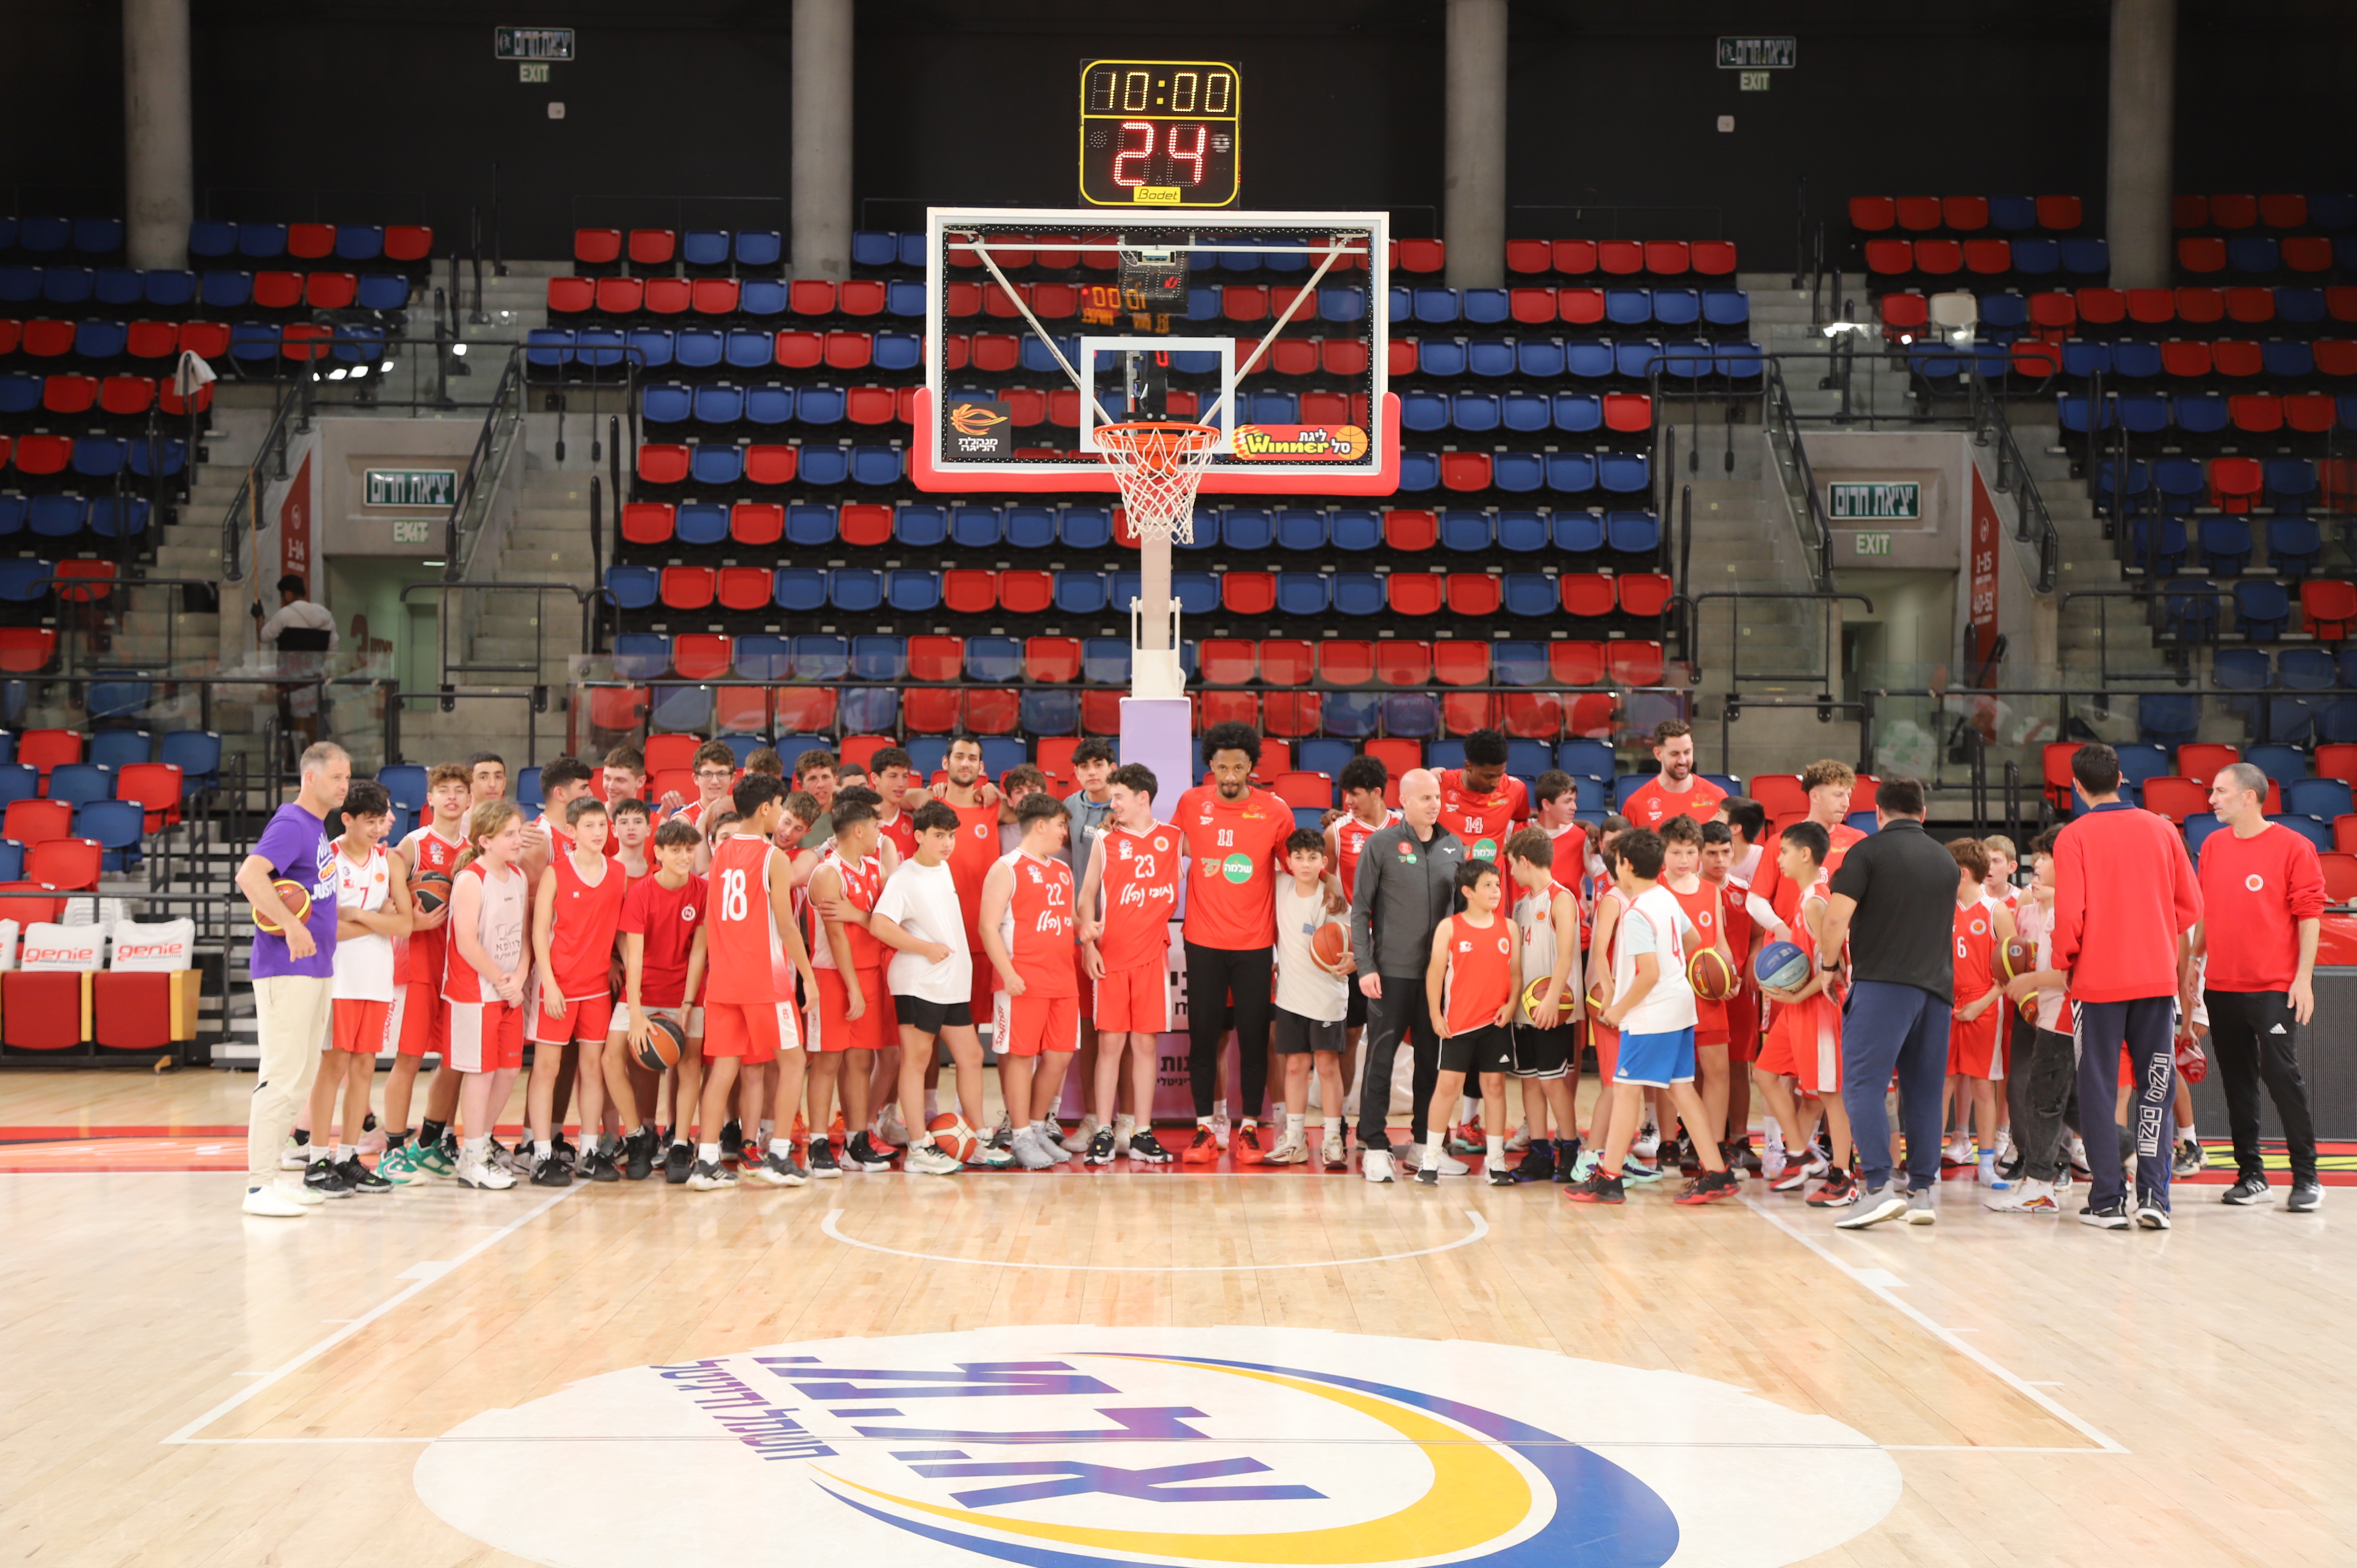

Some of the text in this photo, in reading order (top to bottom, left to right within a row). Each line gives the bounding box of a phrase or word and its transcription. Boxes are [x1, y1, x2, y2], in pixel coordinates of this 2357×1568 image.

[520, 65, 550, 83] EXIT
[1740, 73, 1769, 91] EXIT
[1109, 71, 1231, 112] 10:00
[1113, 121, 1207, 186] 24
[1137, 189, 1178, 199] Bodet
[958, 437, 998, 446] מנהלת
[1245, 433, 1329, 454] Winner
[1299, 428, 1327, 442] ליגת
[1331, 438, 1351, 454] סל
[371, 474, 450, 504] יציאת חרום
[1835, 487, 1913, 515] יציאת חרום
[393, 521, 429, 543] EXIT
[1856, 534, 1890, 554] EXIT
[1464, 816, 1484, 834] 14
[1217, 828, 1234, 847] 11
[1473, 848, 1497, 857] שלמה
[1134, 854, 1155, 879] 23
[1224, 863, 1252, 874] שלמה
[360, 887, 369, 909] 7
[720, 868, 748, 921] 18
[1046, 883, 1065, 906] 22
[1521, 926, 1532, 947] 14
[1670, 915, 1683, 966] 4
[1956, 936, 1967, 958] 6
[24, 947, 93, 963] genie
[117, 943, 183, 961] genie
[996, 1005, 1006, 1047] STARTER
